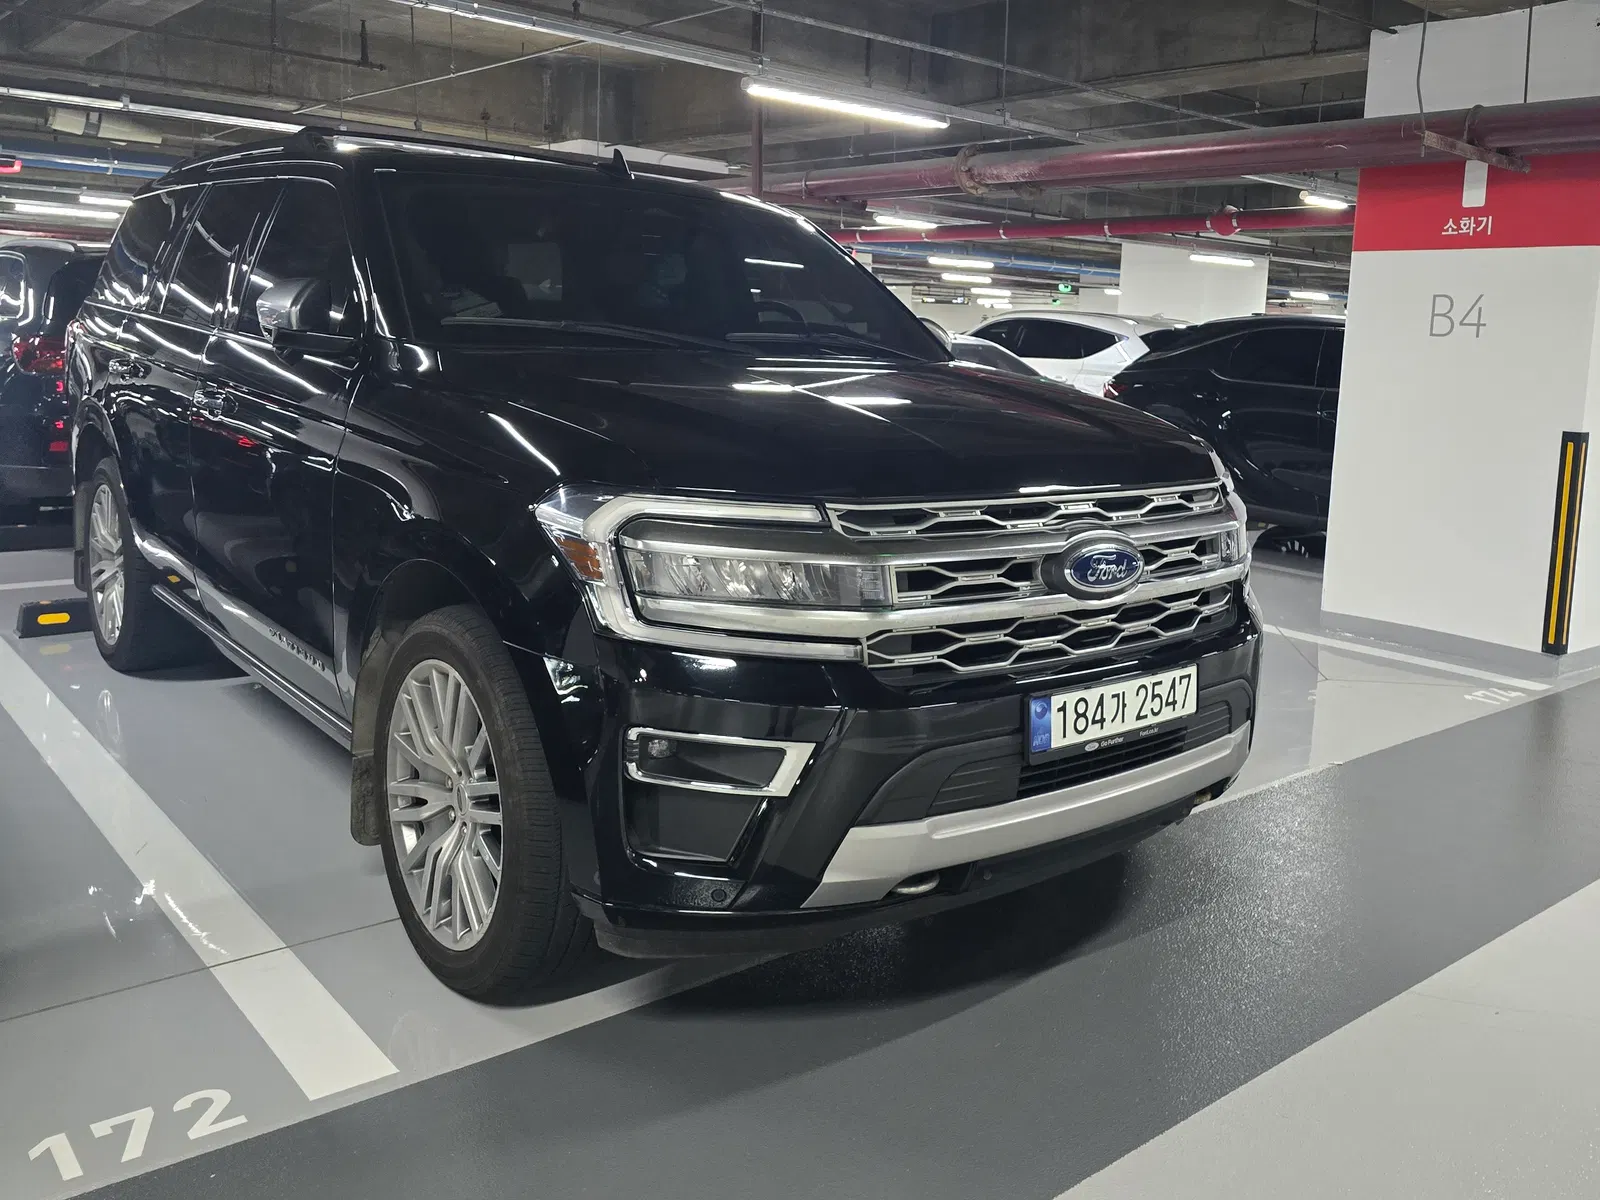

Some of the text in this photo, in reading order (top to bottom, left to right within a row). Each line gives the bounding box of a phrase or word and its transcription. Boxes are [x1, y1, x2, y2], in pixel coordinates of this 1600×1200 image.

[1441, 215, 1494, 236] 소화기
[1428, 293, 1488, 339] B4
[1086, 554, 1128, 582] Ford
[1056, 673, 1192, 739] 184가 2547
[1463, 688, 1527, 705] 174
[27, 1088, 249, 1181] 172
